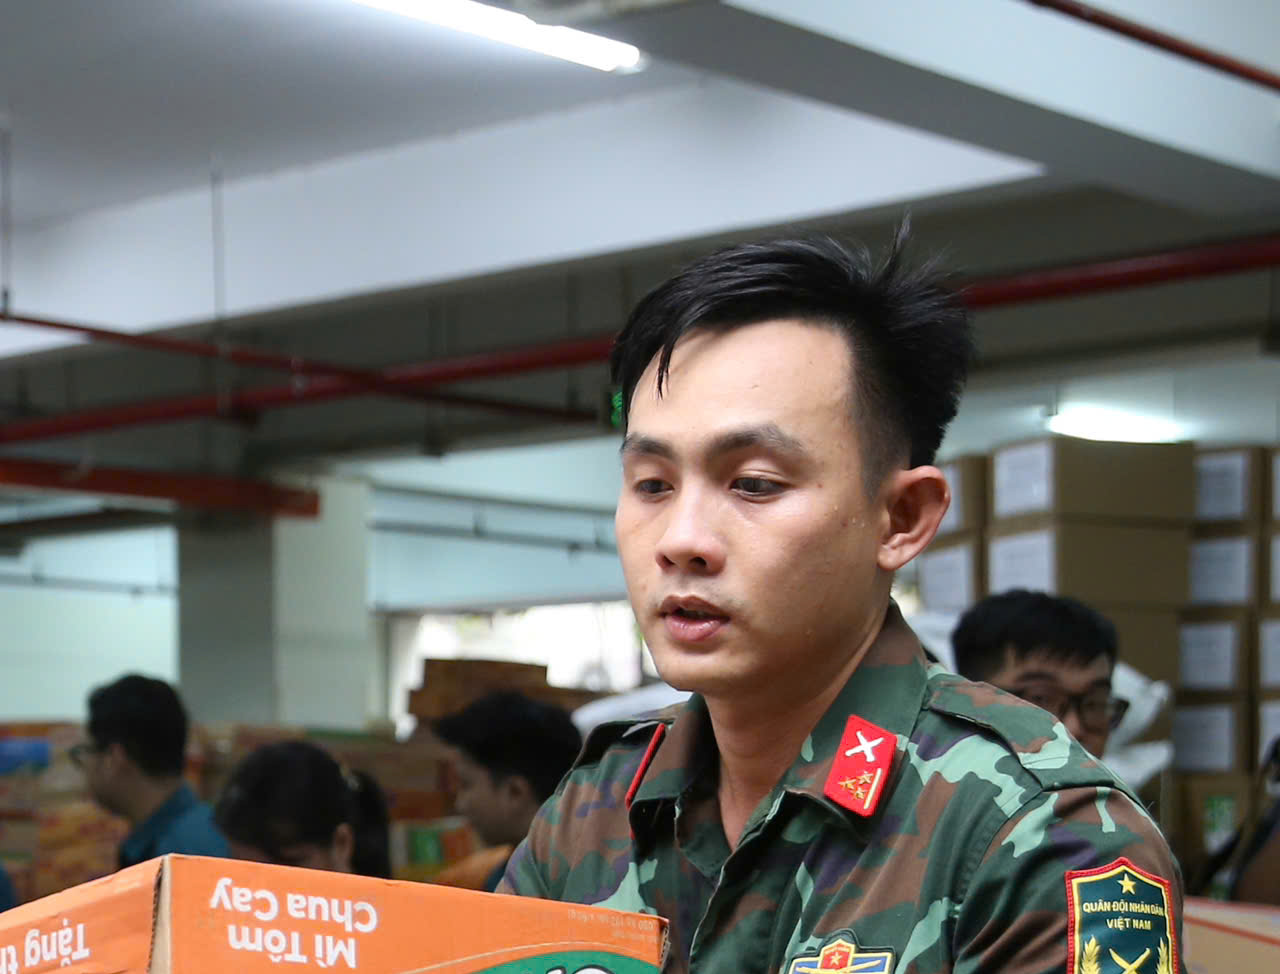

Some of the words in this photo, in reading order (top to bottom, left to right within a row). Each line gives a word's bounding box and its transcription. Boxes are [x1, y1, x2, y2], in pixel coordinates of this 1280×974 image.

[209, 877, 279, 921] Cay
[288, 894, 378, 933] Chua
[1083, 899, 1111, 913] QUÂN
[1112, 899, 1128, 913] ĐỘI
[1129, 901, 1150, 914] NHÂN
[1107, 916, 1131, 930] VIỆT
[1133, 919, 1152, 930] NAM
[24, 919, 90, 967] Tặng
[228, 924, 308, 964] Tôm
[319, 938, 357, 968] Mì
